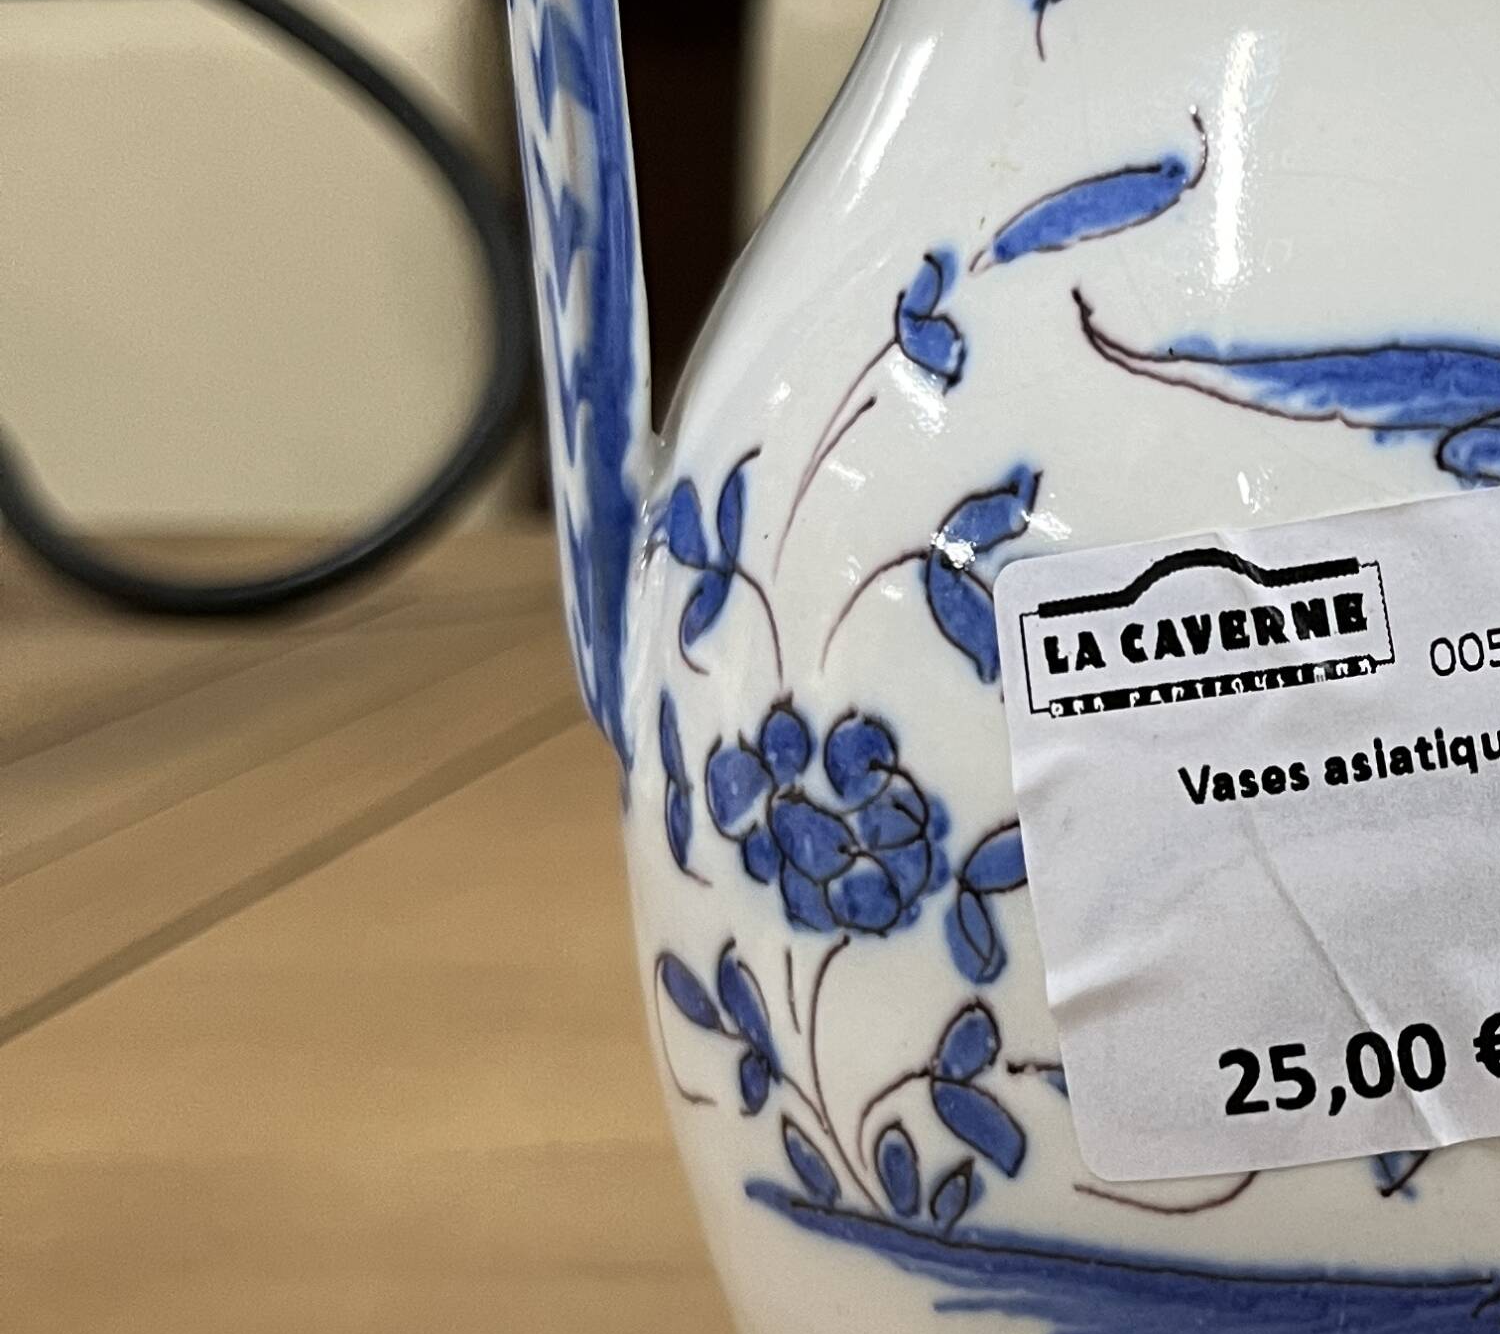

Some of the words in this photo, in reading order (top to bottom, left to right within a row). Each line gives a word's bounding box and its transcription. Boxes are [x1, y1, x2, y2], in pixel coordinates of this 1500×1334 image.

[1043, 630, 1106, 674] LA
[1120, 592, 1368, 664] CAVERNE
[1178, 755, 1310, 805] Vases
[1218, 1022, 1447, 1117] 25,00
